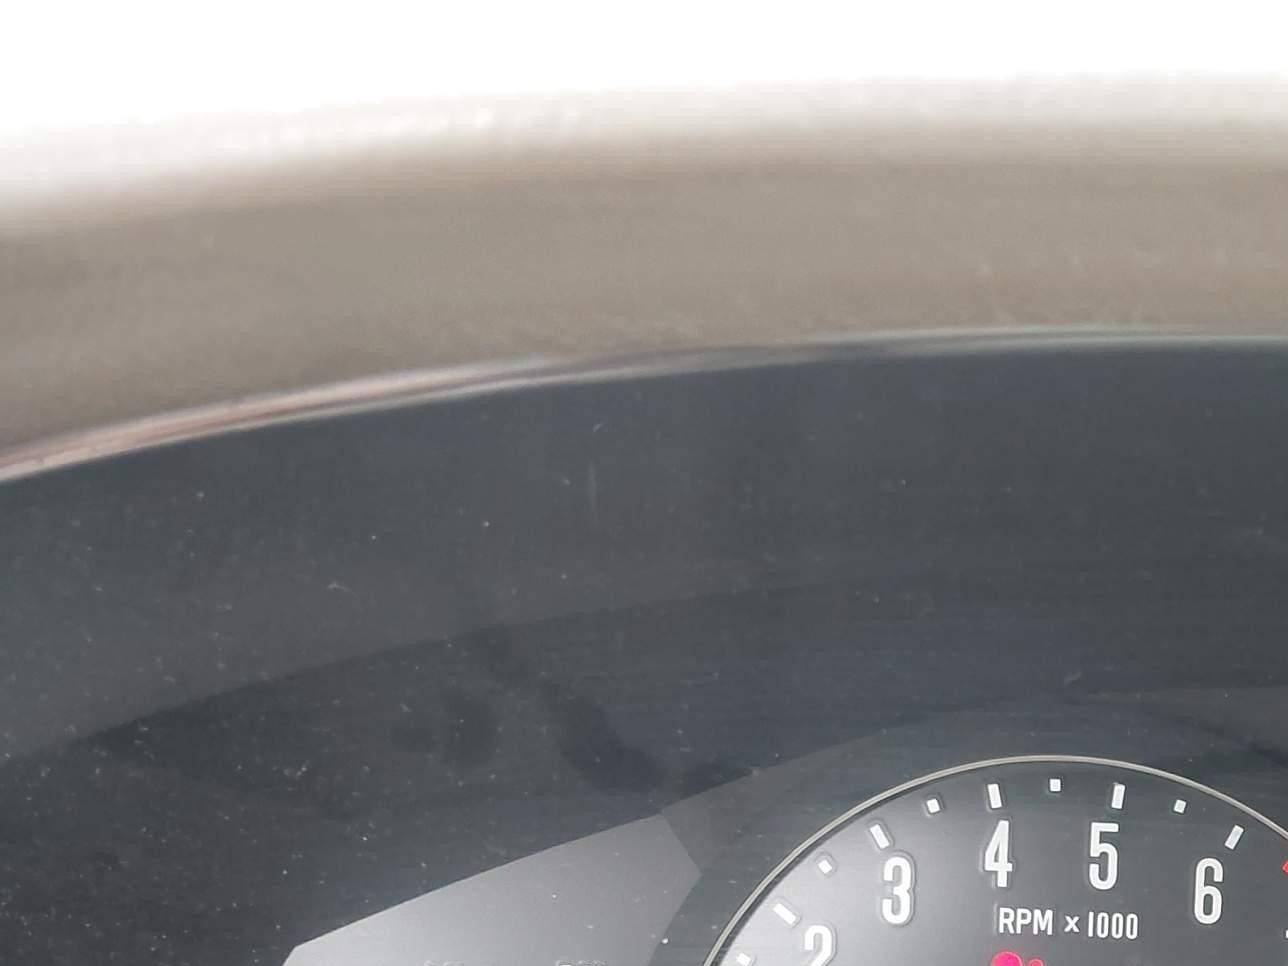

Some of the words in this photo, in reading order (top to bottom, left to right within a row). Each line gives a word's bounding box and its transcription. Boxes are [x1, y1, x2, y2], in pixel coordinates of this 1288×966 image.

[984, 820, 1013, 888] 4
[1089, 822, 1119, 890] 5
[882, 856, 912, 924] 3
[999, 907, 1053, 936] RPM
[1088, 911, 1138, 940] 1000
[1194, 857, 1224, 924] 6
